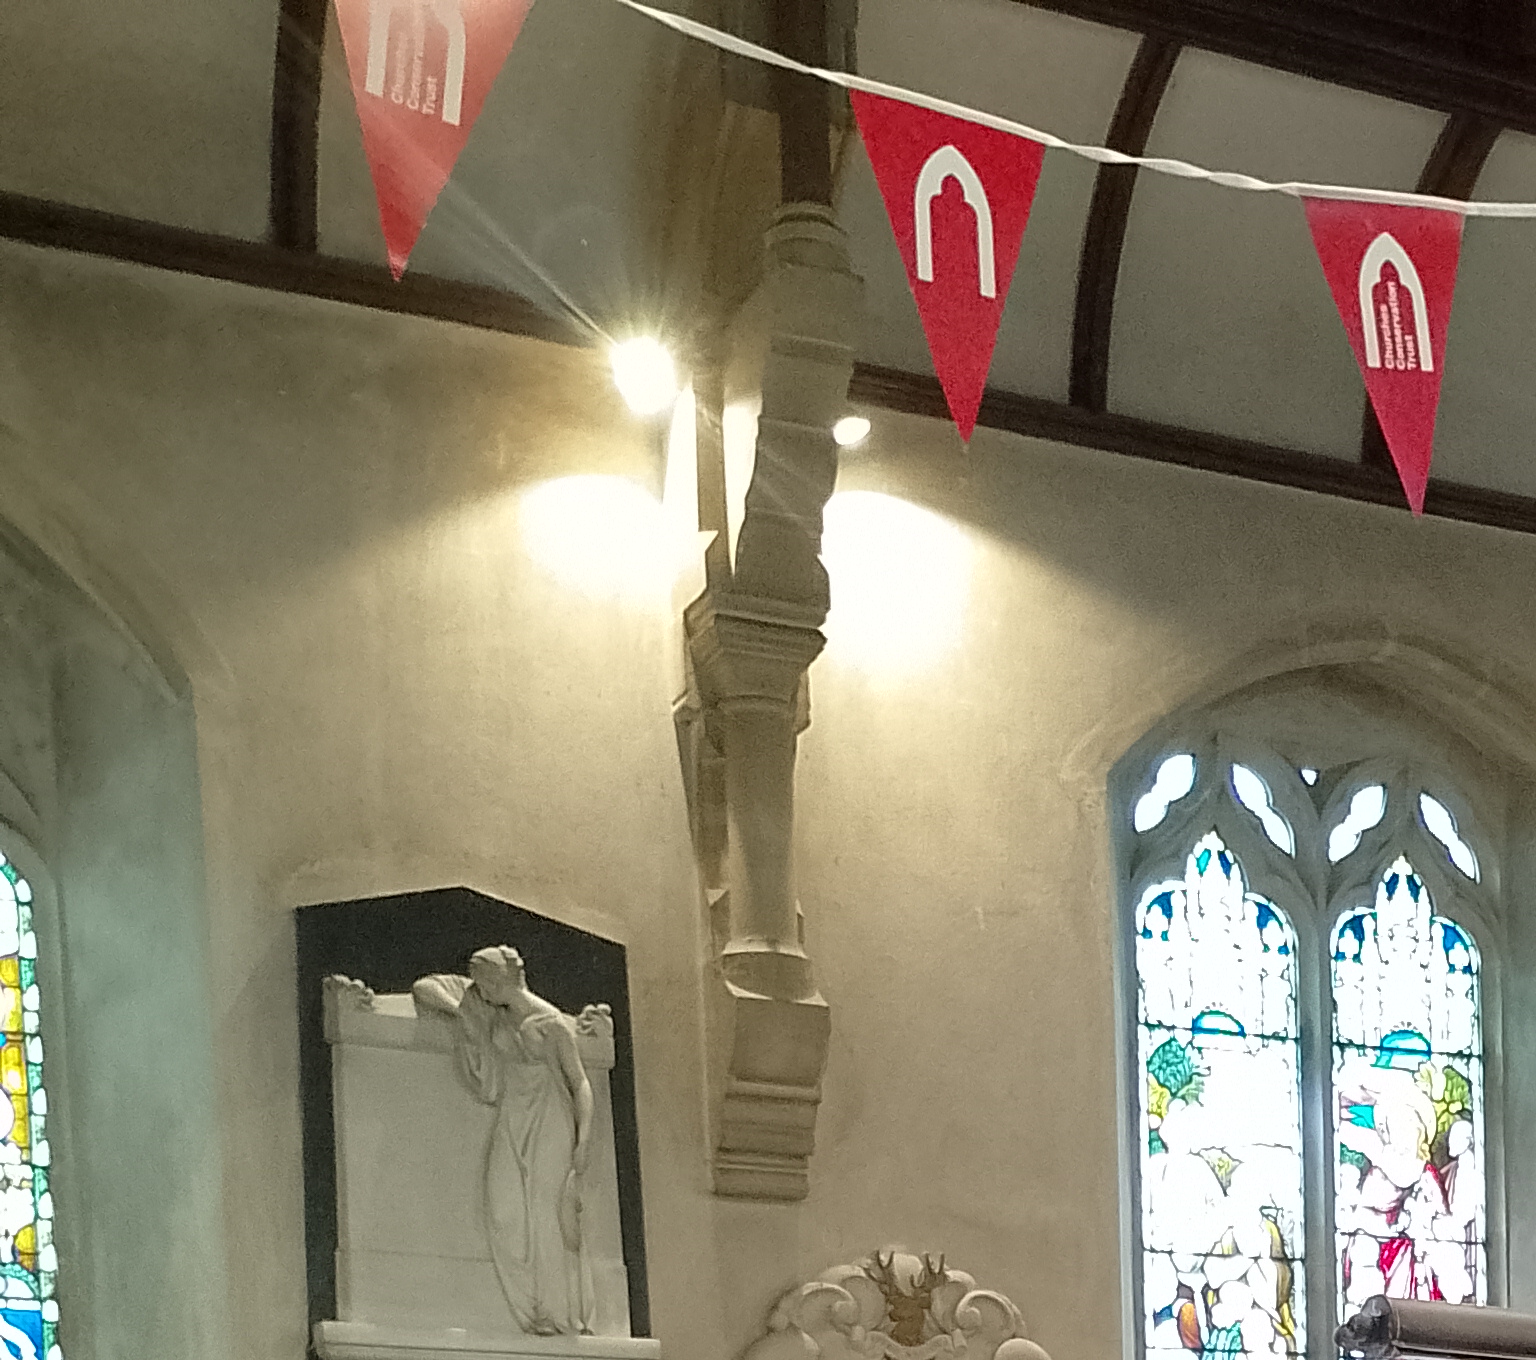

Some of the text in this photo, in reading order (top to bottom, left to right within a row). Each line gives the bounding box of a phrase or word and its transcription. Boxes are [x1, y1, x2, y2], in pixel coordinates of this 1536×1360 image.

[421, 75, 437, 115] Trust
[1379, 303, 1395, 370] Churches
[1386, 281, 1405, 371] Conservation
[1404, 334, 1417, 371] Trust
